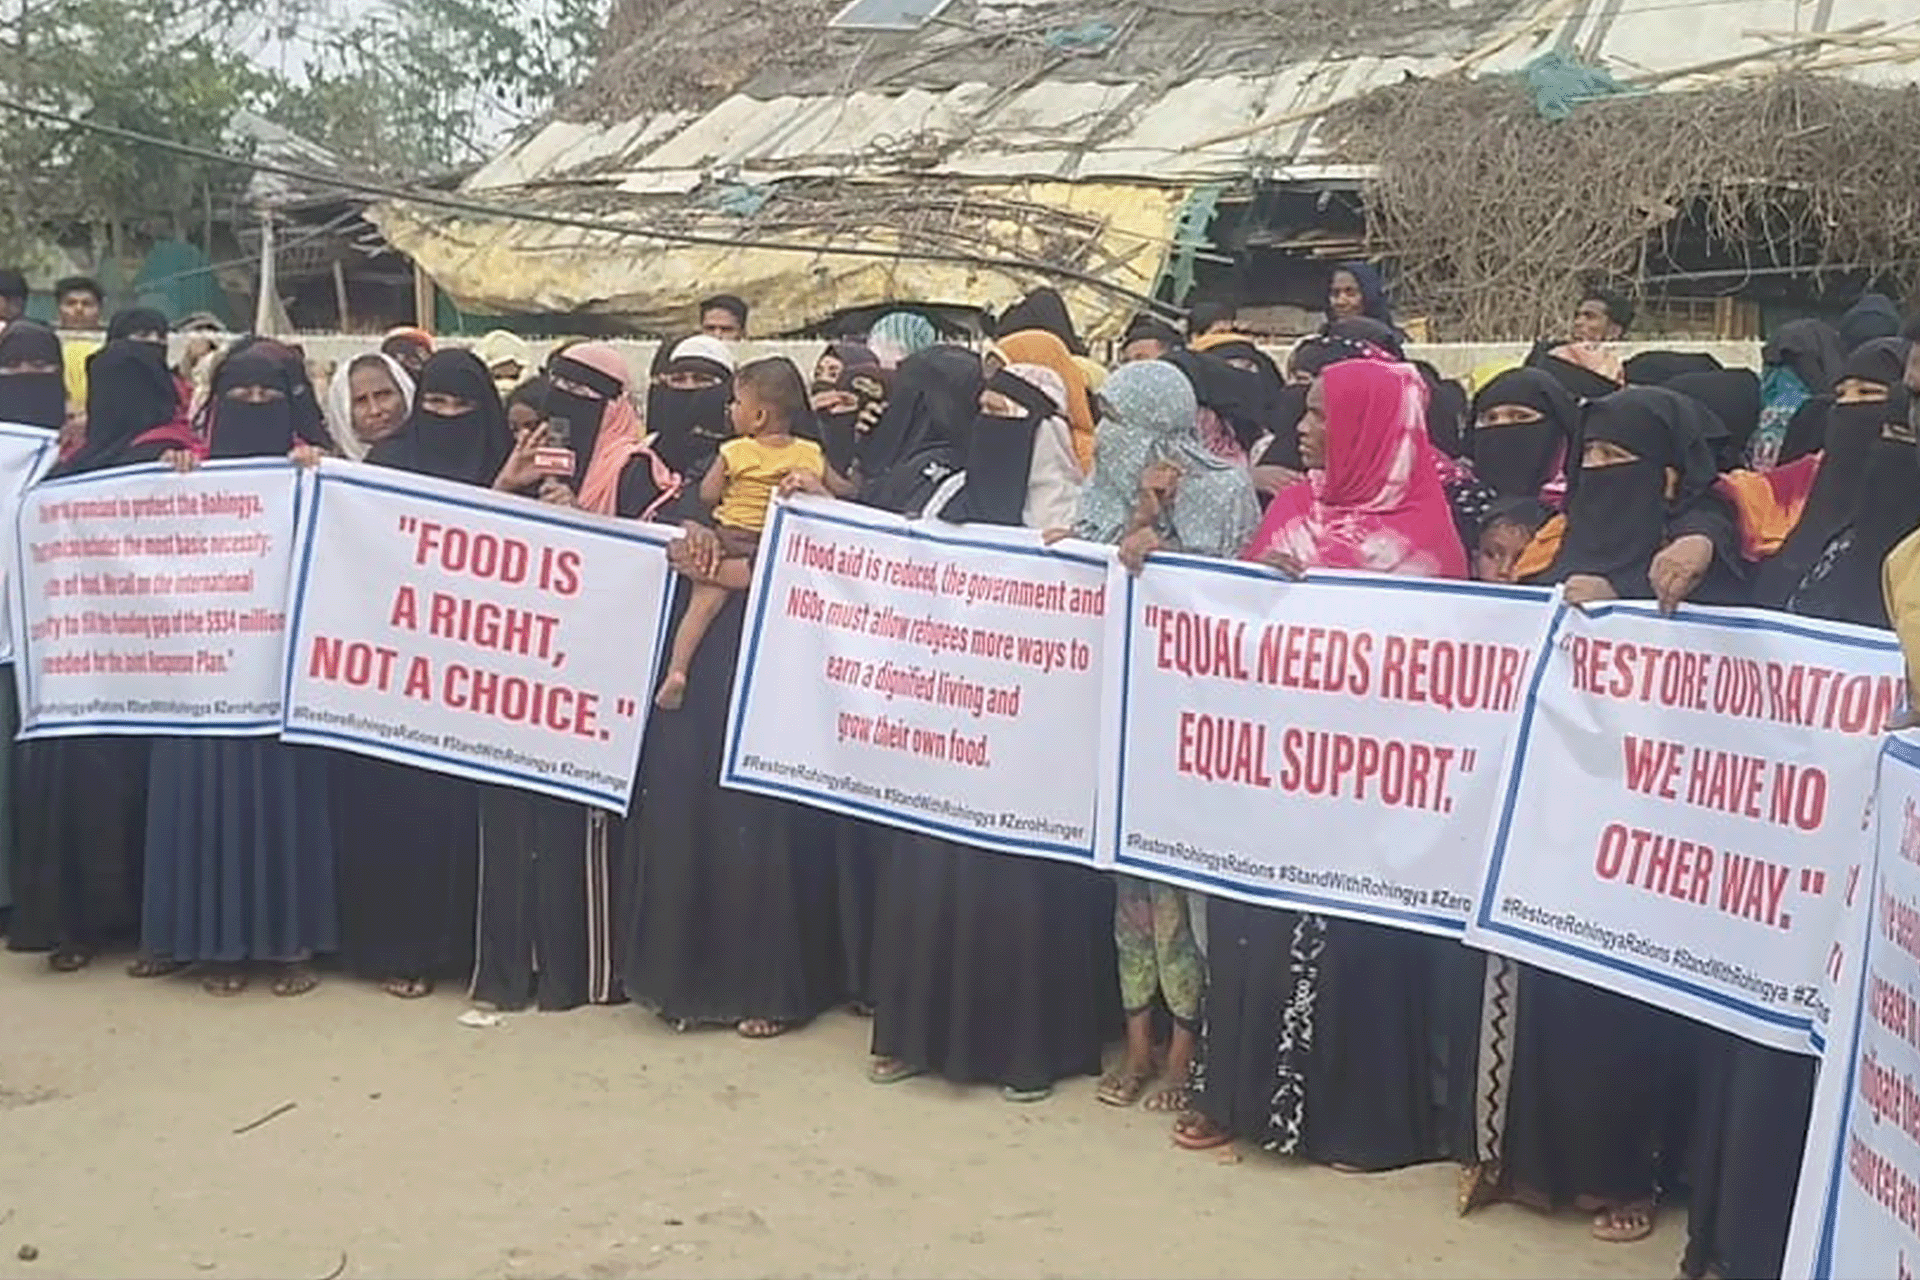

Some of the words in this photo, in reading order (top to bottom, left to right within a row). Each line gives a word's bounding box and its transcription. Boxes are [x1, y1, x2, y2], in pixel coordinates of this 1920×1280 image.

[399, 516, 529, 584] "FOOD
[539, 547, 581, 595] IS
[786, 533, 801, 563] If
[802, 536, 837, 571] food
[837, 545, 865, 578] aid
[866, 549, 882, 581] is
[883, 556, 938, 597] reduced,
[942, 561, 967, 596] the
[966, 572, 1067, 612] government
[1069, 583, 1106, 616] and
[391, 586, 418, 630] A
[430, 593, 567, 667] RIGHT,
[787, 586, 825, 622] NGOs
[826, 602, 869, 633] must
[869, 605, 911, 640] allow
[909, 613, 968, 655] refugees
[971, 629, 1014, 660] more
[1017, 636, 1066, 673] ways
[1070, 637, 1090, 670] to
[1145, 605, 1249, 681] "EQUAL
[1257, 622, 1373, 696] NEEDS
[1381, 635, 1530, 712] REQUIR
[309, 636, 398, 692] NOT
[404, 657, 431, 700] A
[443, 664, 636, 741] CHOICE."
[826, 656, 861, 686] earn
[862, 664, 874, 687] a
[875, 660, 937, 701] dignified
[937, 670, 984, 718] living
[987, 684, 1021, 716] and
[1714, 655, 1762, 720] OUR
[838, 711, 874, 743] grow
[873, 714, 910, 750] their
[913, 728, 946, 759] own
[949, 727, 990, 768] food.
[1178, 712, 1271, 788] EQUAL
[1280, 727, 1477, 813] SUPPORT."
[1624, 735, 1685, 800] WE
[1686, 746, 1767, 819] HAVE
[1770, 761, 1827, 831] NO
[1000, 813, 1085, 840] #ZeroHunger
[1126, 832, 1275, 880] #RestoreRohingyaRations
[1279, 864, 1427, 908] #StandWithRohingya
[1431, 889, 1472, 913] #Zero
[1595, 823, 1714, 906] OTHER
[1719, 851, 1826, 931] WAY."
[1501, 897, 1670, 964] #RestoreRohingyaRations
[1672, 948, 1788, 1004] #StandWithRohingya
